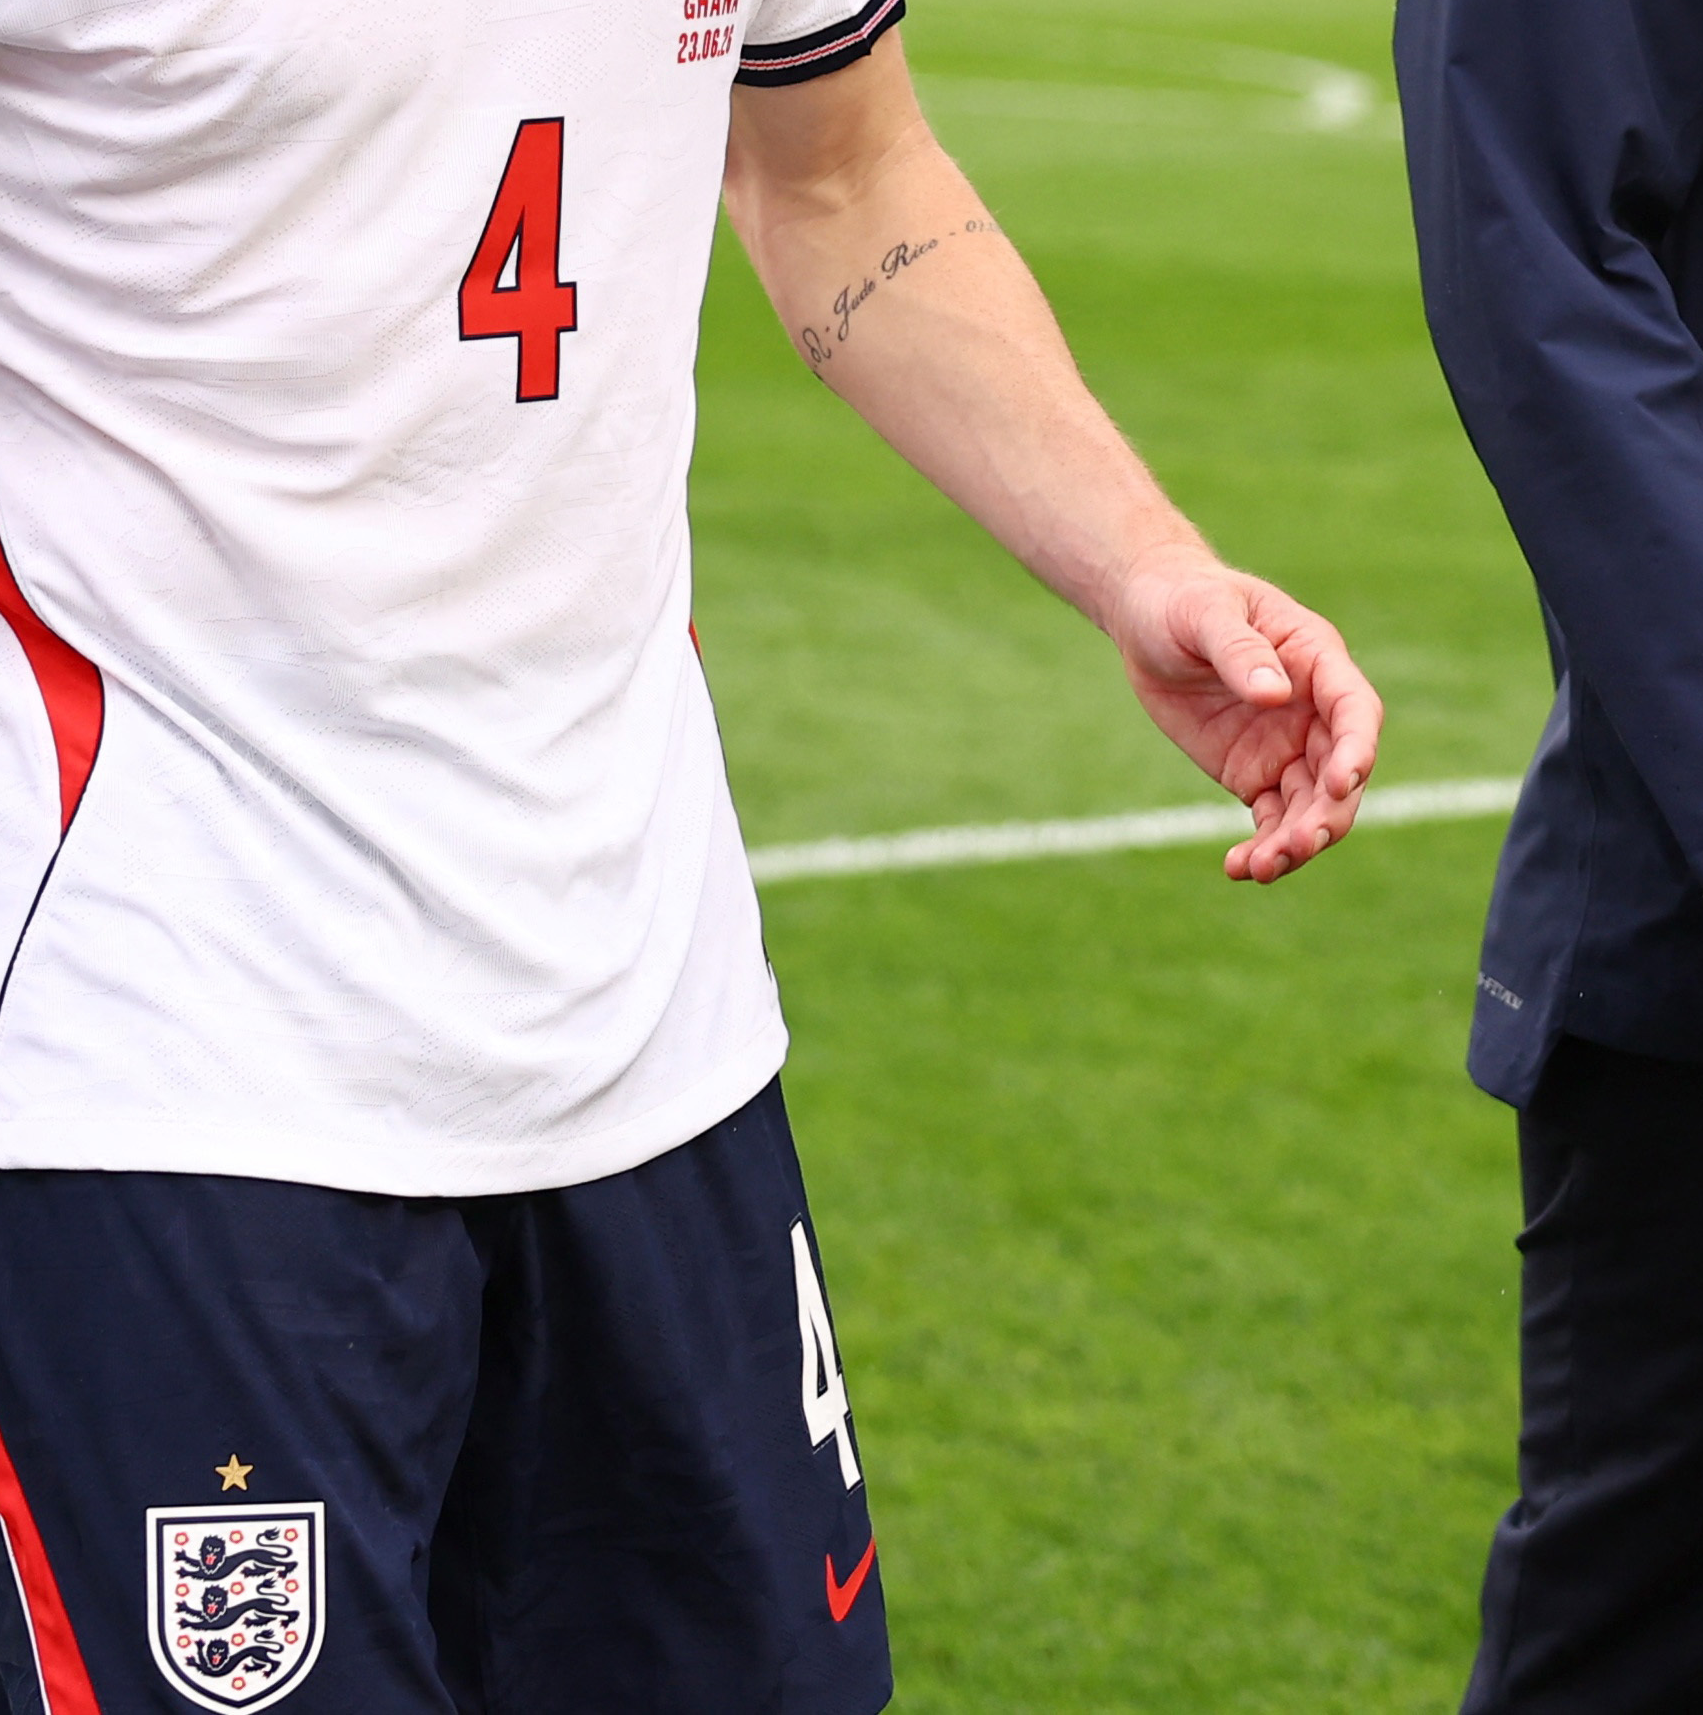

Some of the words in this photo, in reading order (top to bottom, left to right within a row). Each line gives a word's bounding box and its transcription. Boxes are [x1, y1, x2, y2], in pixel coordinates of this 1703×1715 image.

[458, 116, 577, 403] 4
[833, 278, 876, 342] Jude
[881, 238, 939, 280] Rico
[788, 1219, 862, 1492] 4
